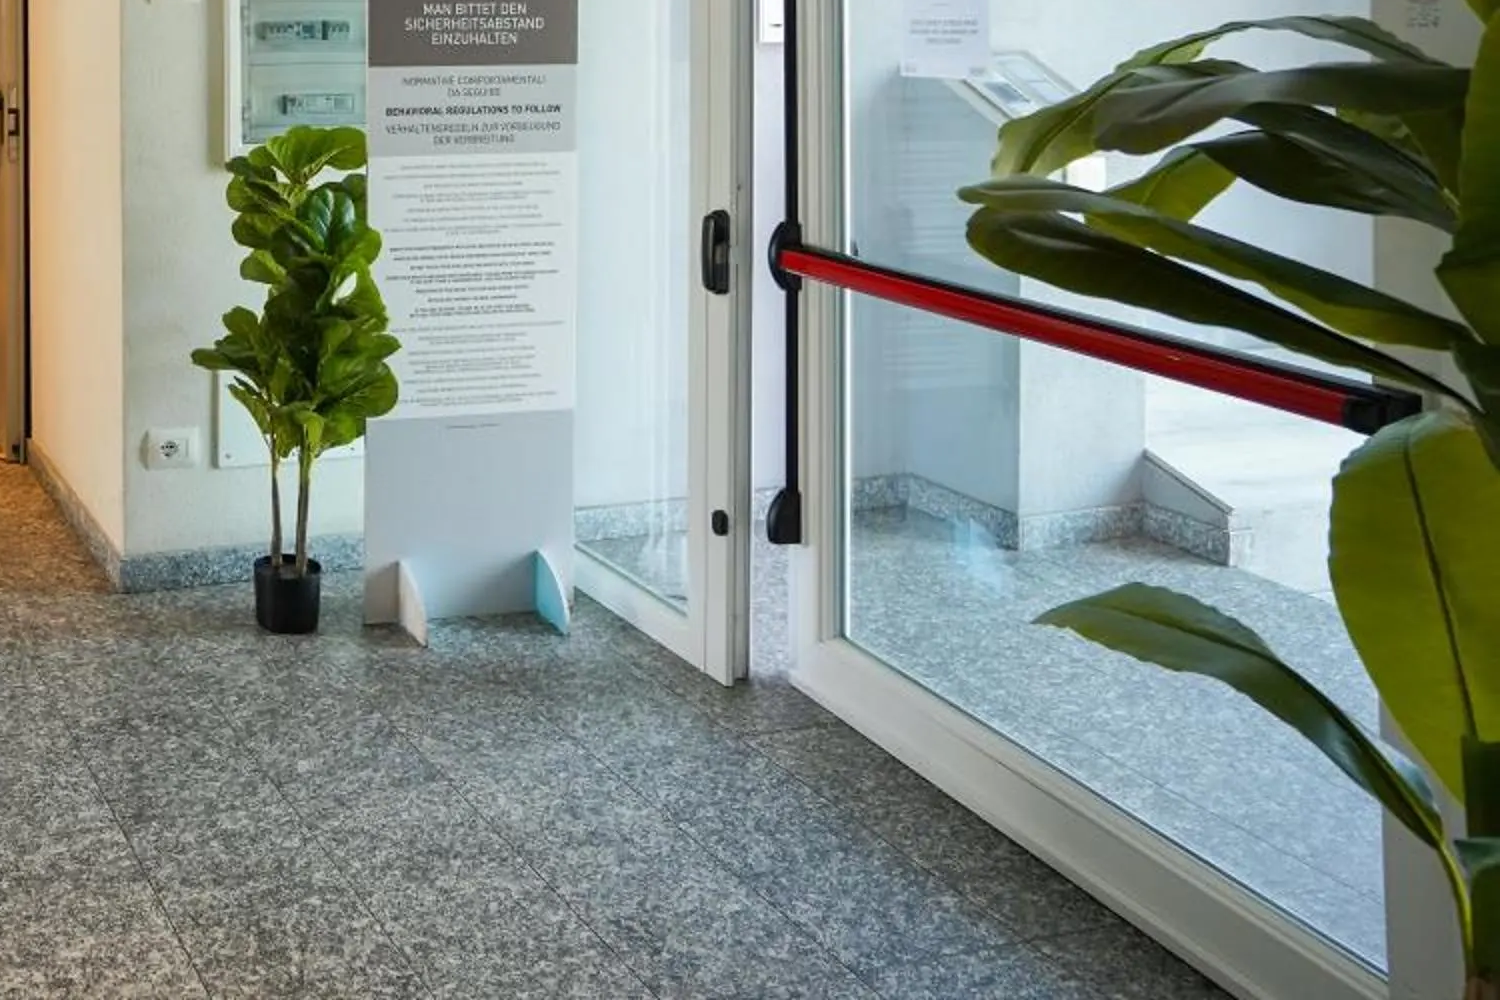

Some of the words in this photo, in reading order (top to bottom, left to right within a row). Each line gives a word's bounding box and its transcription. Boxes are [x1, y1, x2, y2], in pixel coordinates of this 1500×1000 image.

[423, 3, 451, 15] MAN
[455, 3, 496, 15] BITTET
[501, 2, 527, 14] DEN
[404, 17, 544, 31] SICHERHEITSABSTAND
[431, 32, 519, 45] EINZUHALTEN
[446, 105, 509, 116] REGULATIONS
[511, 105, 522, 115] TO
[524, 104, 561, 114] FOLLOW
